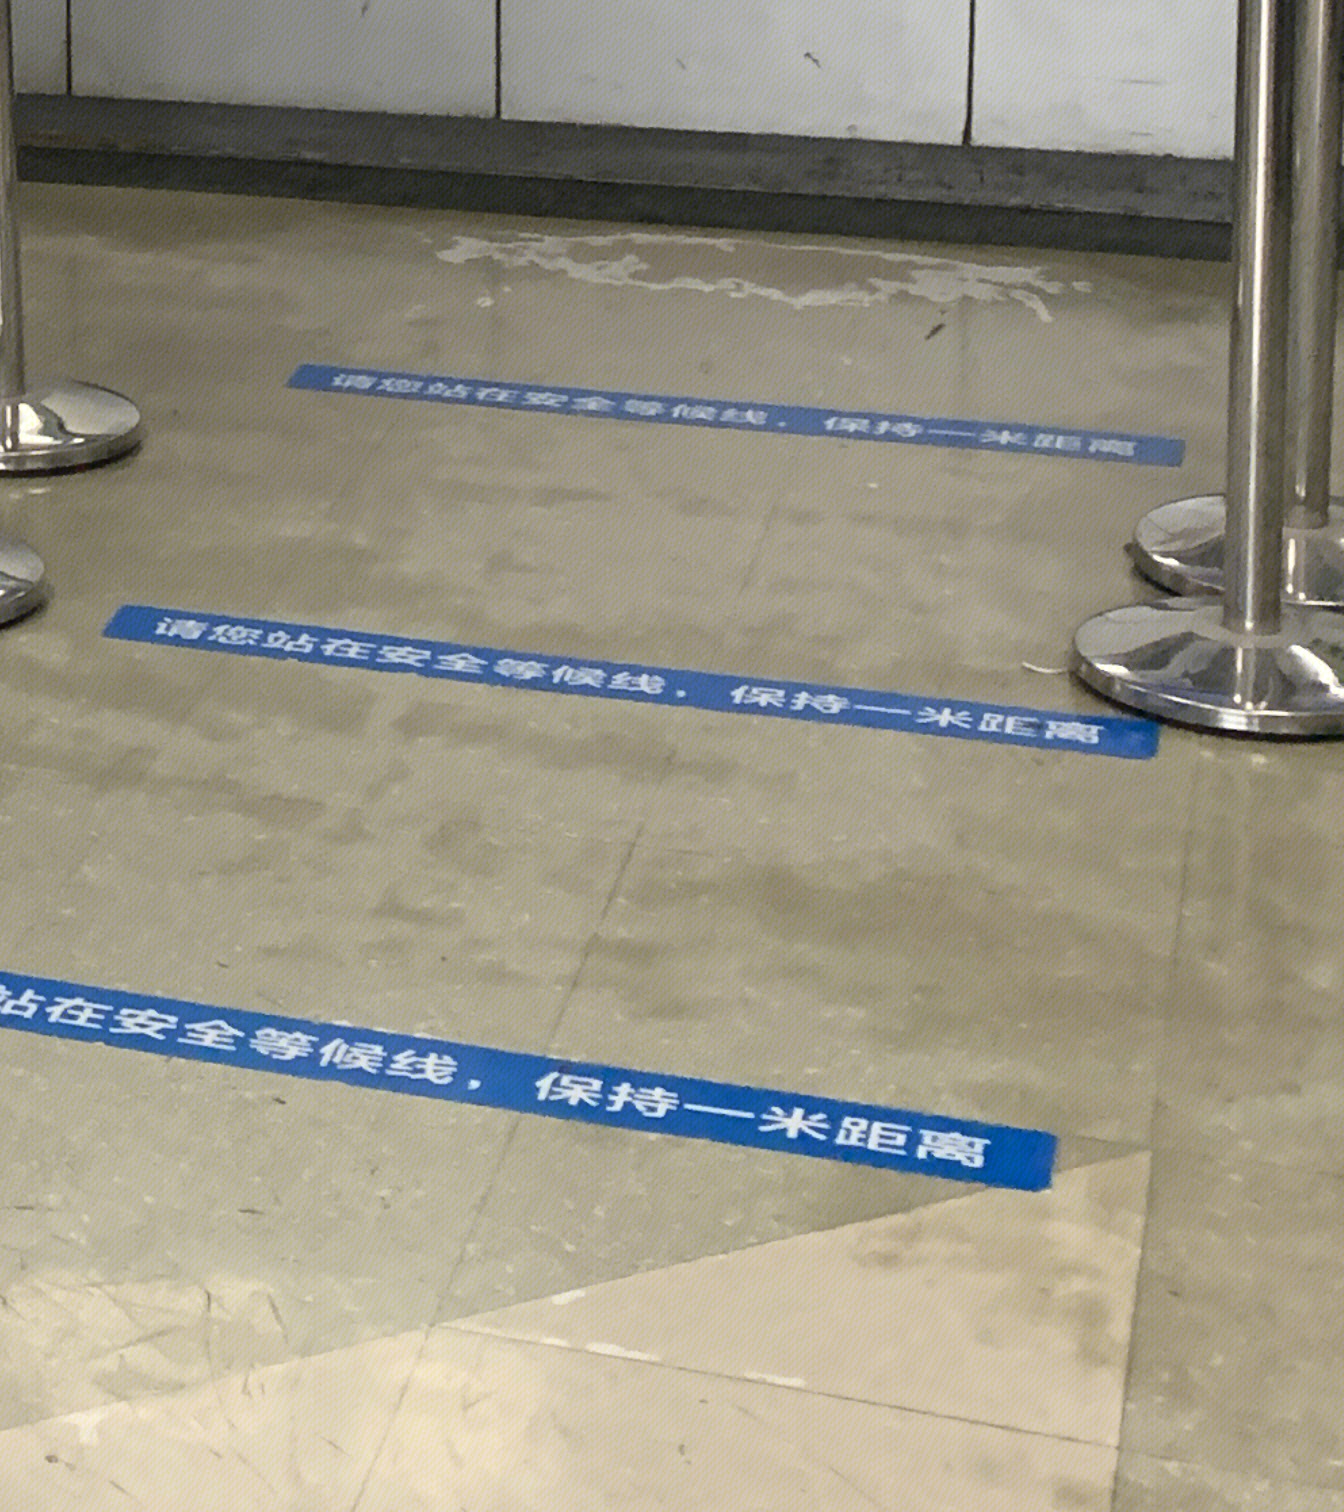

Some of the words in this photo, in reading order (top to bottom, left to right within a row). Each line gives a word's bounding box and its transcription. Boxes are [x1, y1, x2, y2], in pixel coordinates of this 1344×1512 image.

[730, 684, 1106, 745] 保持一米距离
[533, 1070, 993, 1170] 保持一米距离
